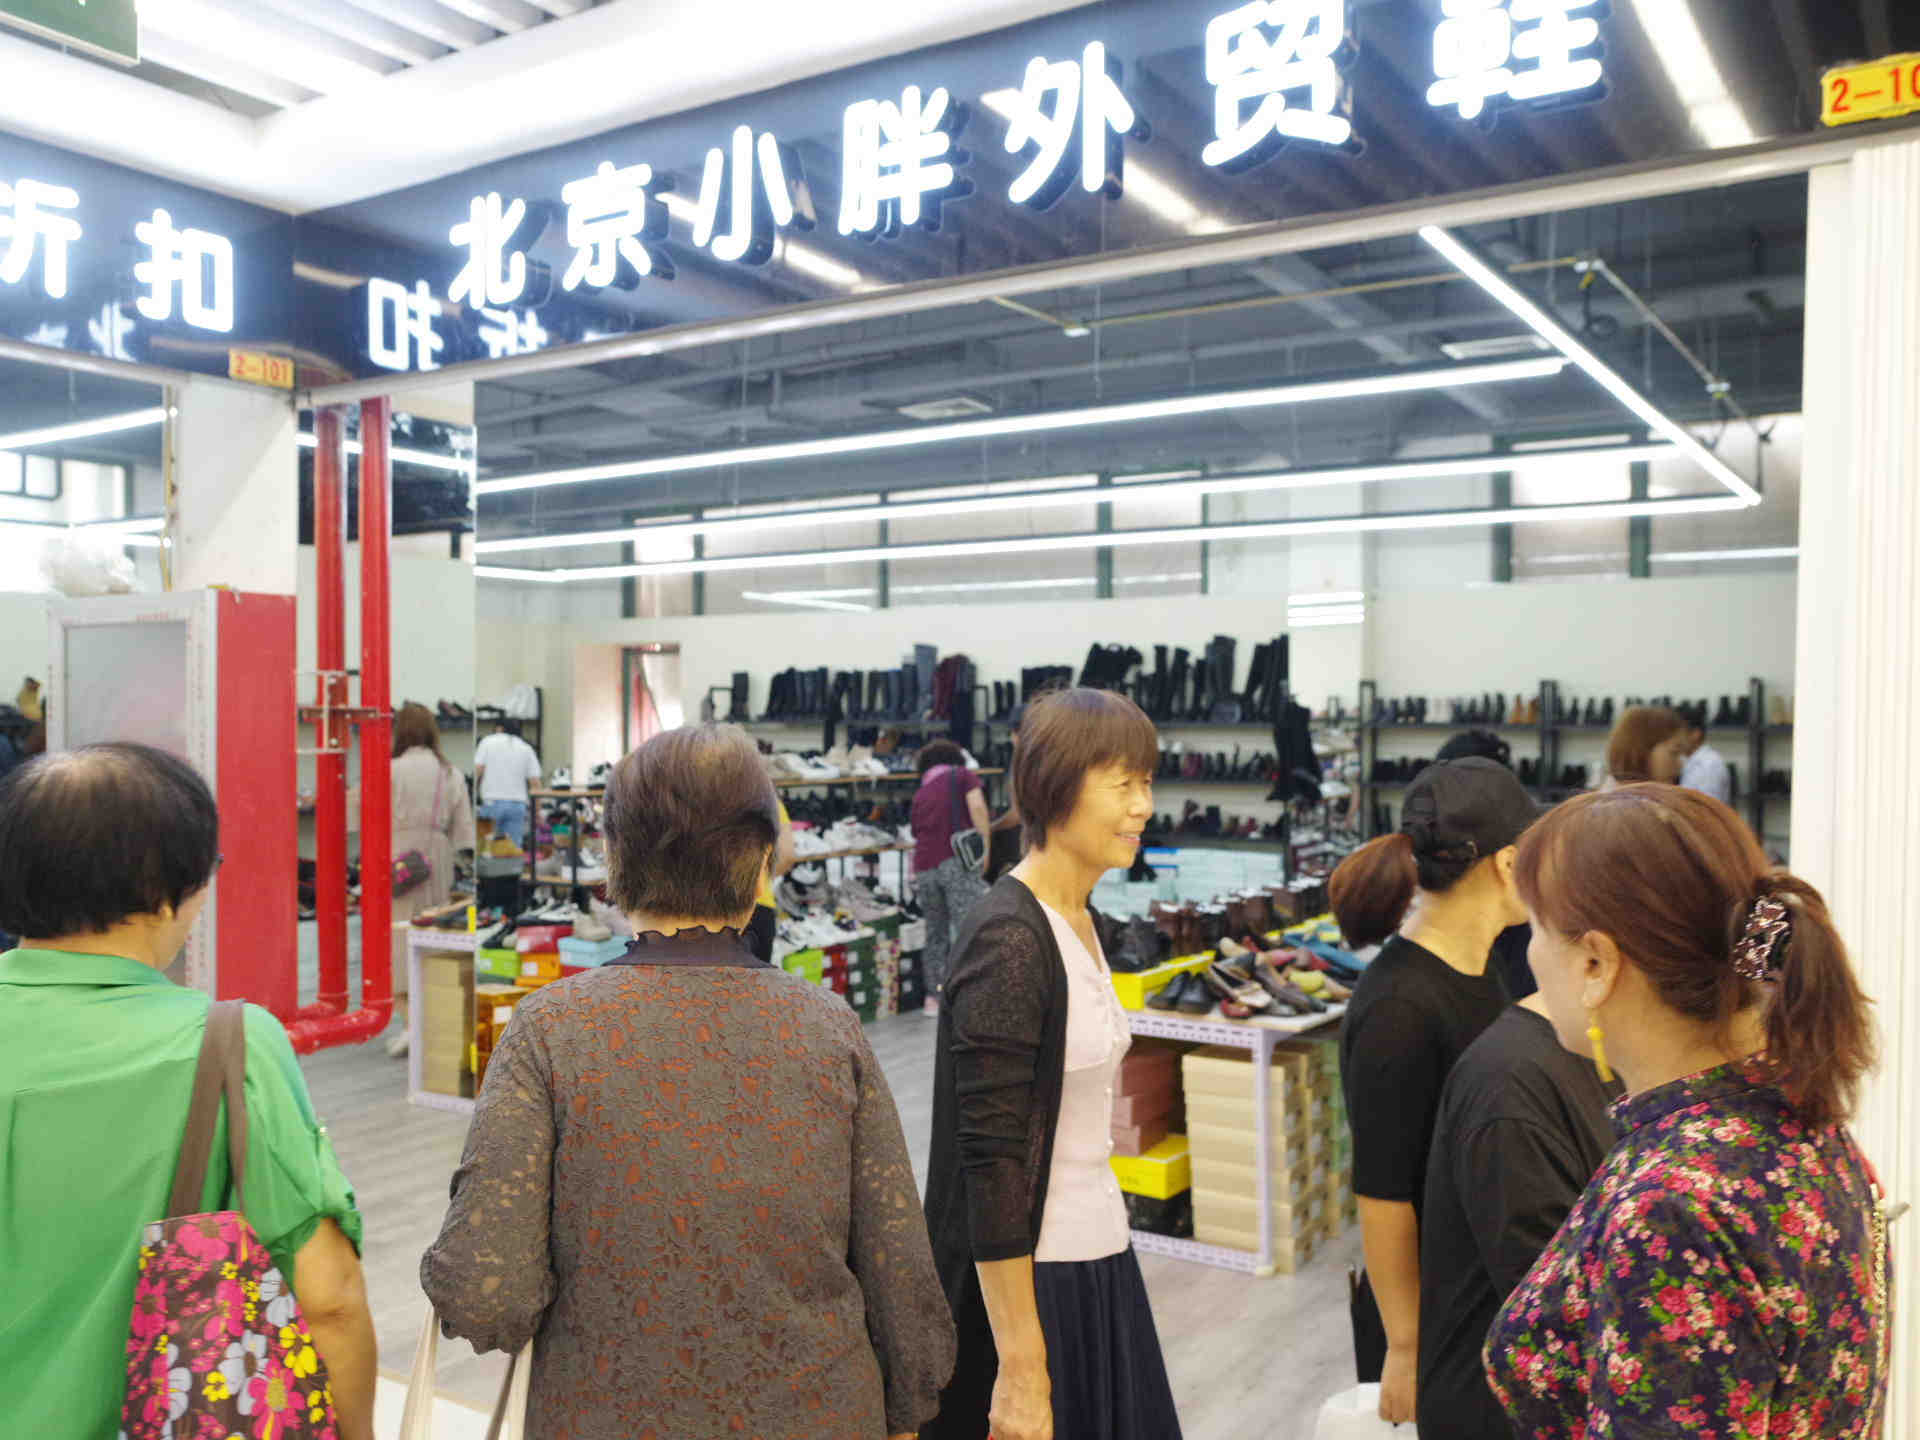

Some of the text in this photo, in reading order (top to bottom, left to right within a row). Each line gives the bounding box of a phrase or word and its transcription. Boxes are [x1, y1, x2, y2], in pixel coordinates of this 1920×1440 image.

[448, 0, 1602, 309] 北京小胖外贸鞋
